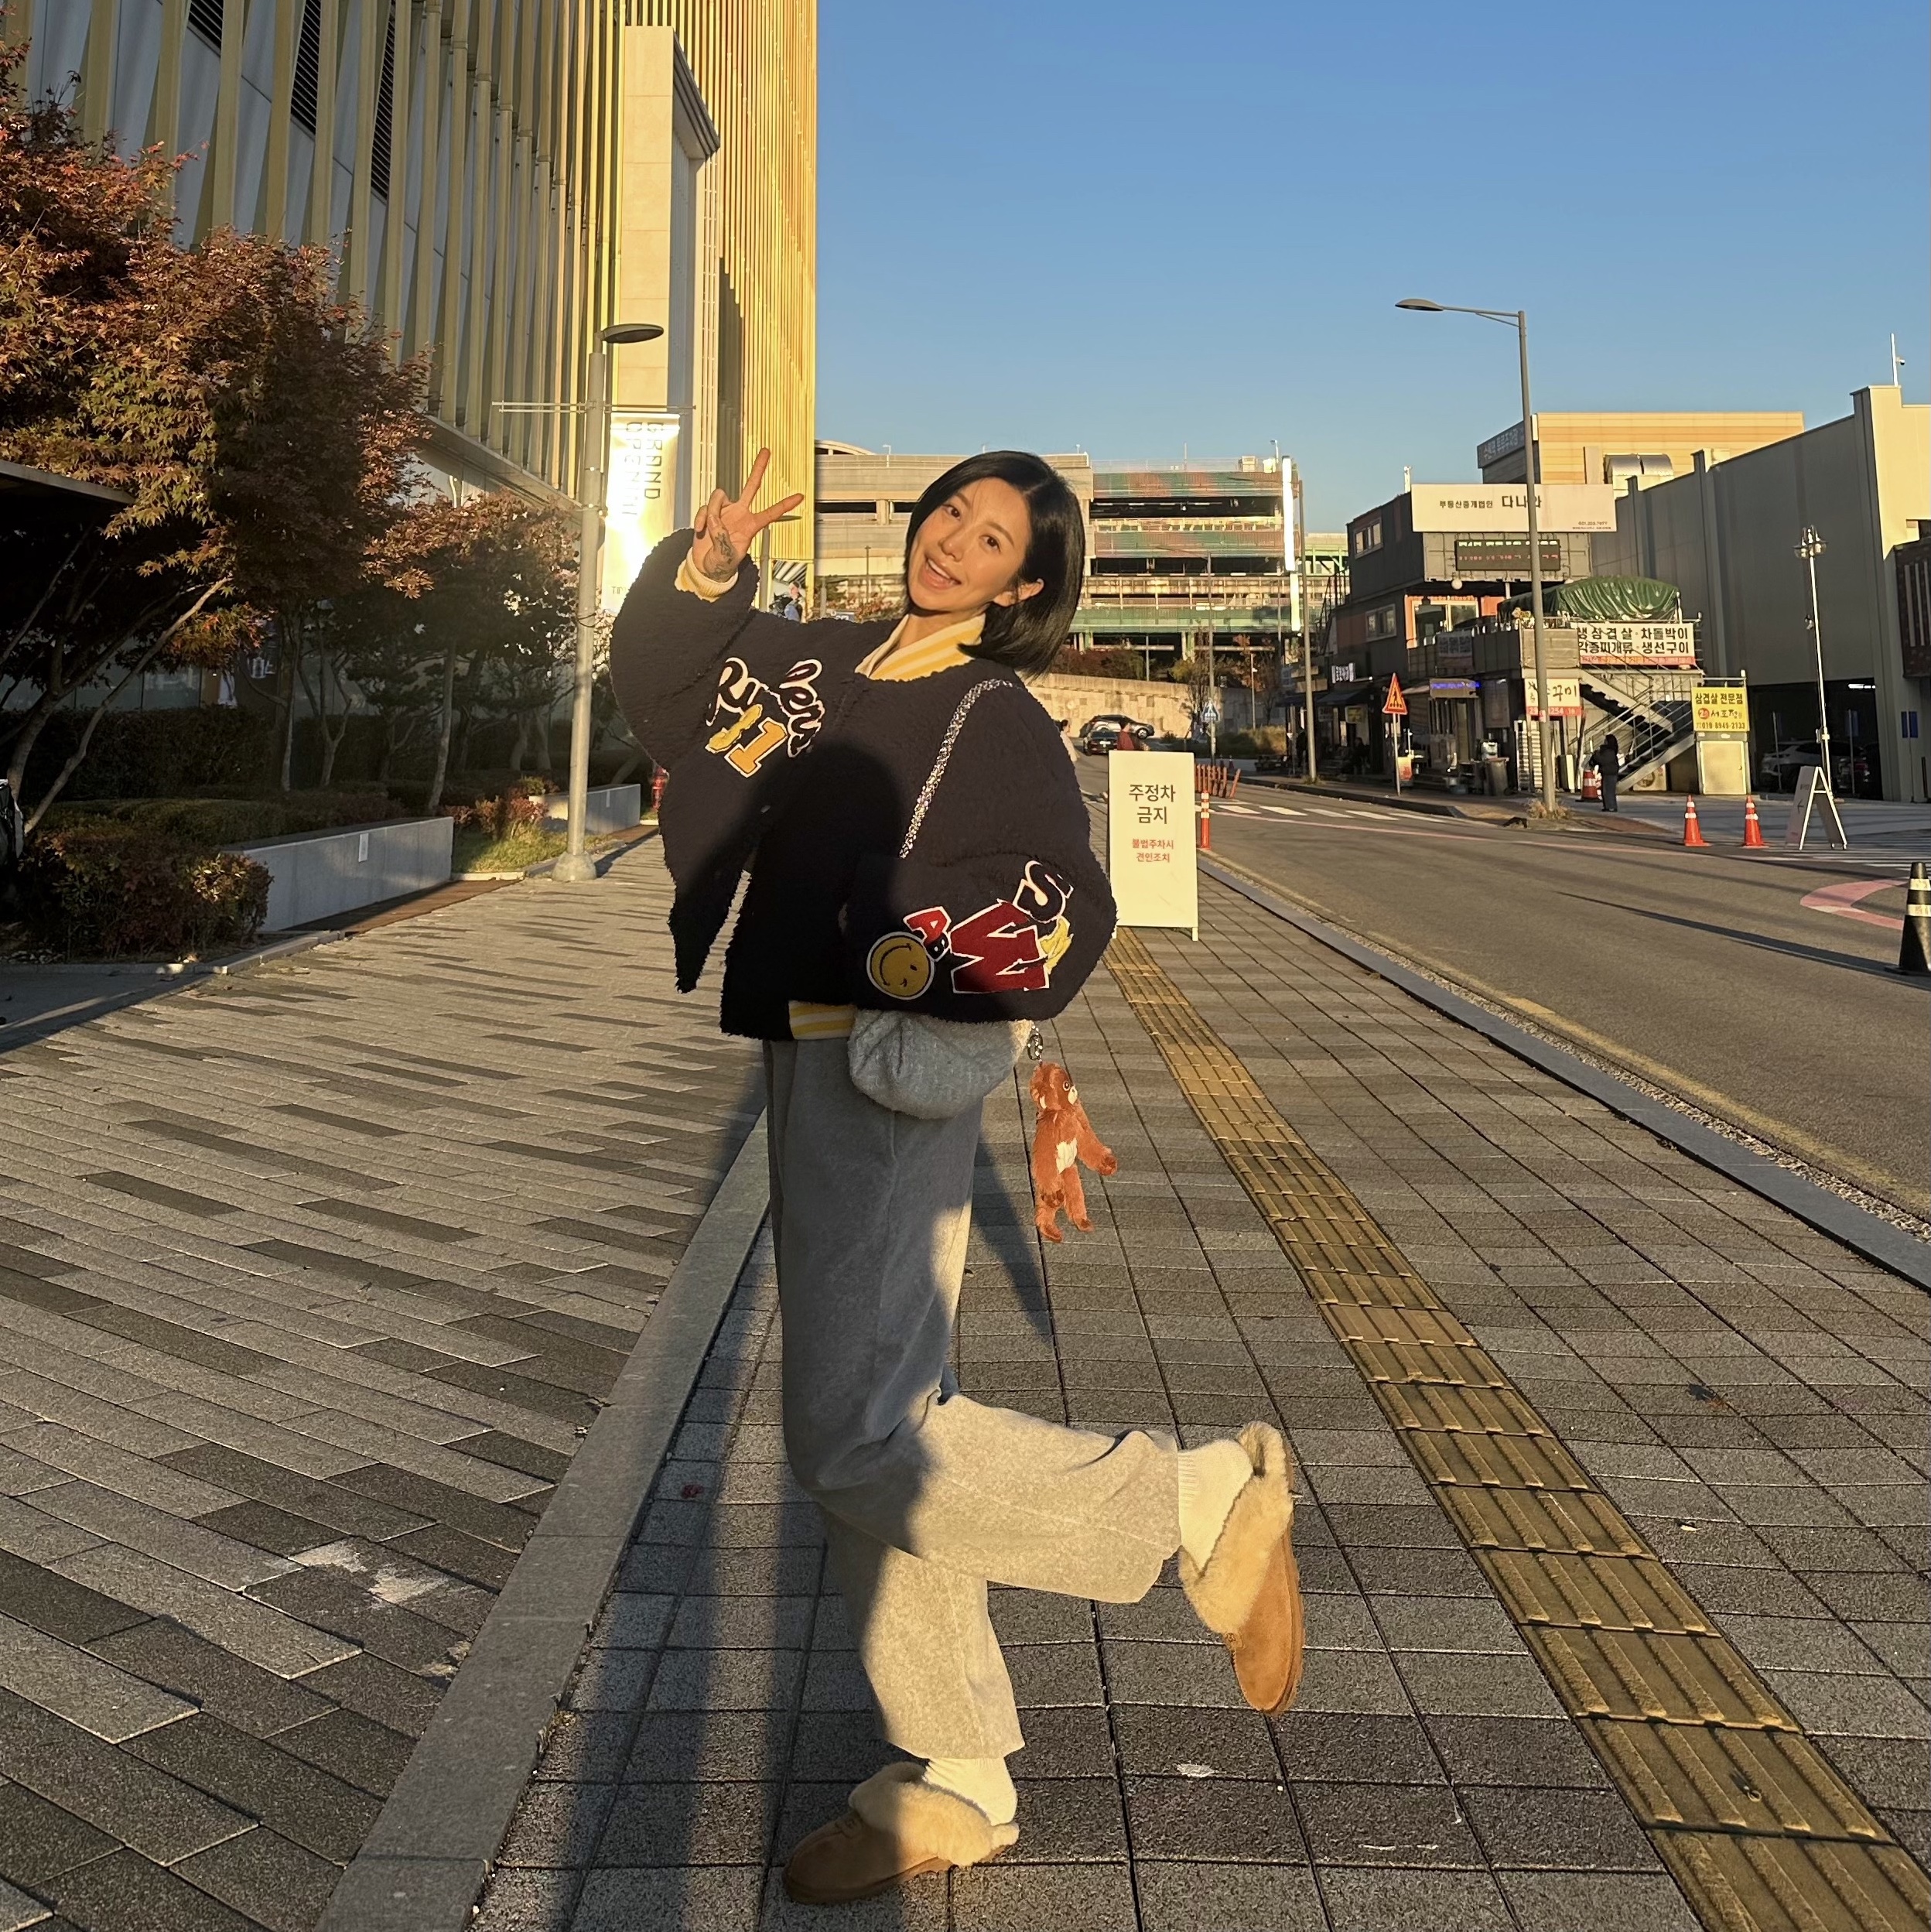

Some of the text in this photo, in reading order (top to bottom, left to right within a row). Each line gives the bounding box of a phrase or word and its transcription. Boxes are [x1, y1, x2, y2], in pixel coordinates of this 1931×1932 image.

[621, 422, 642, 516] OPENIN
[1641, 627, 1688, 640] 차돌박이
[1642, 641, 1689, 654] 생선구이
[1695, 693, 1743, 704] 삼겹살 전문점
[1129, 784, 1176, 802] 주정차
[1136, 806, 1167, 824] 금지
[1132, 839, 1174, 850] 불법주차시
[1136, 853, 1171, 863] 견인조치
